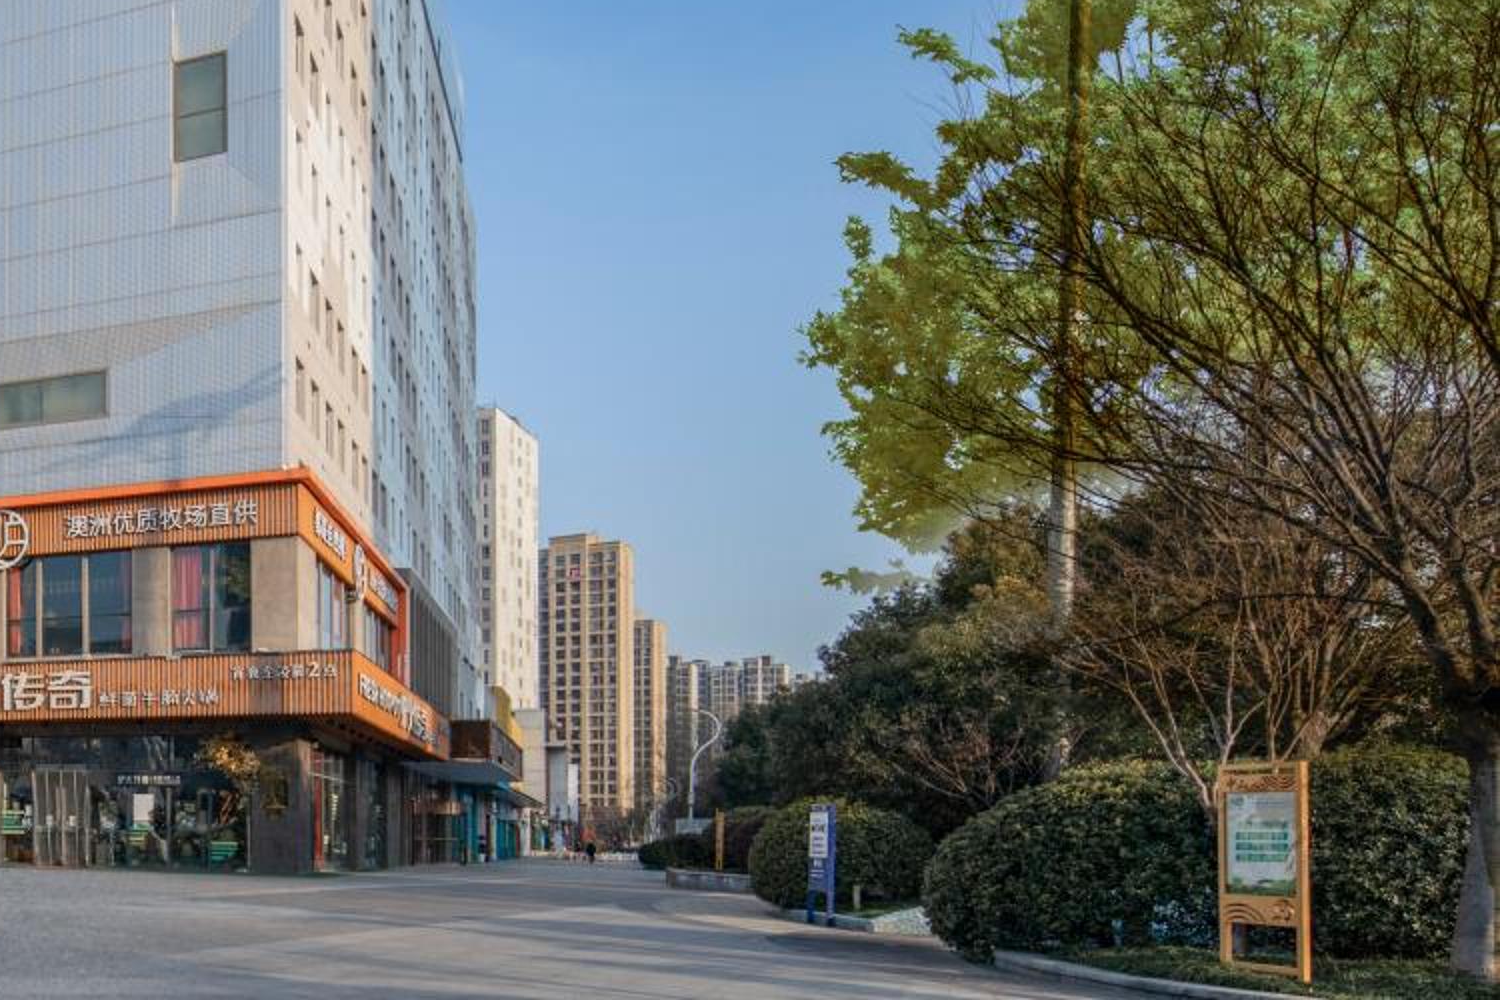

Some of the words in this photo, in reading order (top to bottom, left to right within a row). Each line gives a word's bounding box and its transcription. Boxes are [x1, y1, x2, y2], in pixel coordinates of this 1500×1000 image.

[66, 501, 258, 538] 澳洲优质牧场直供
